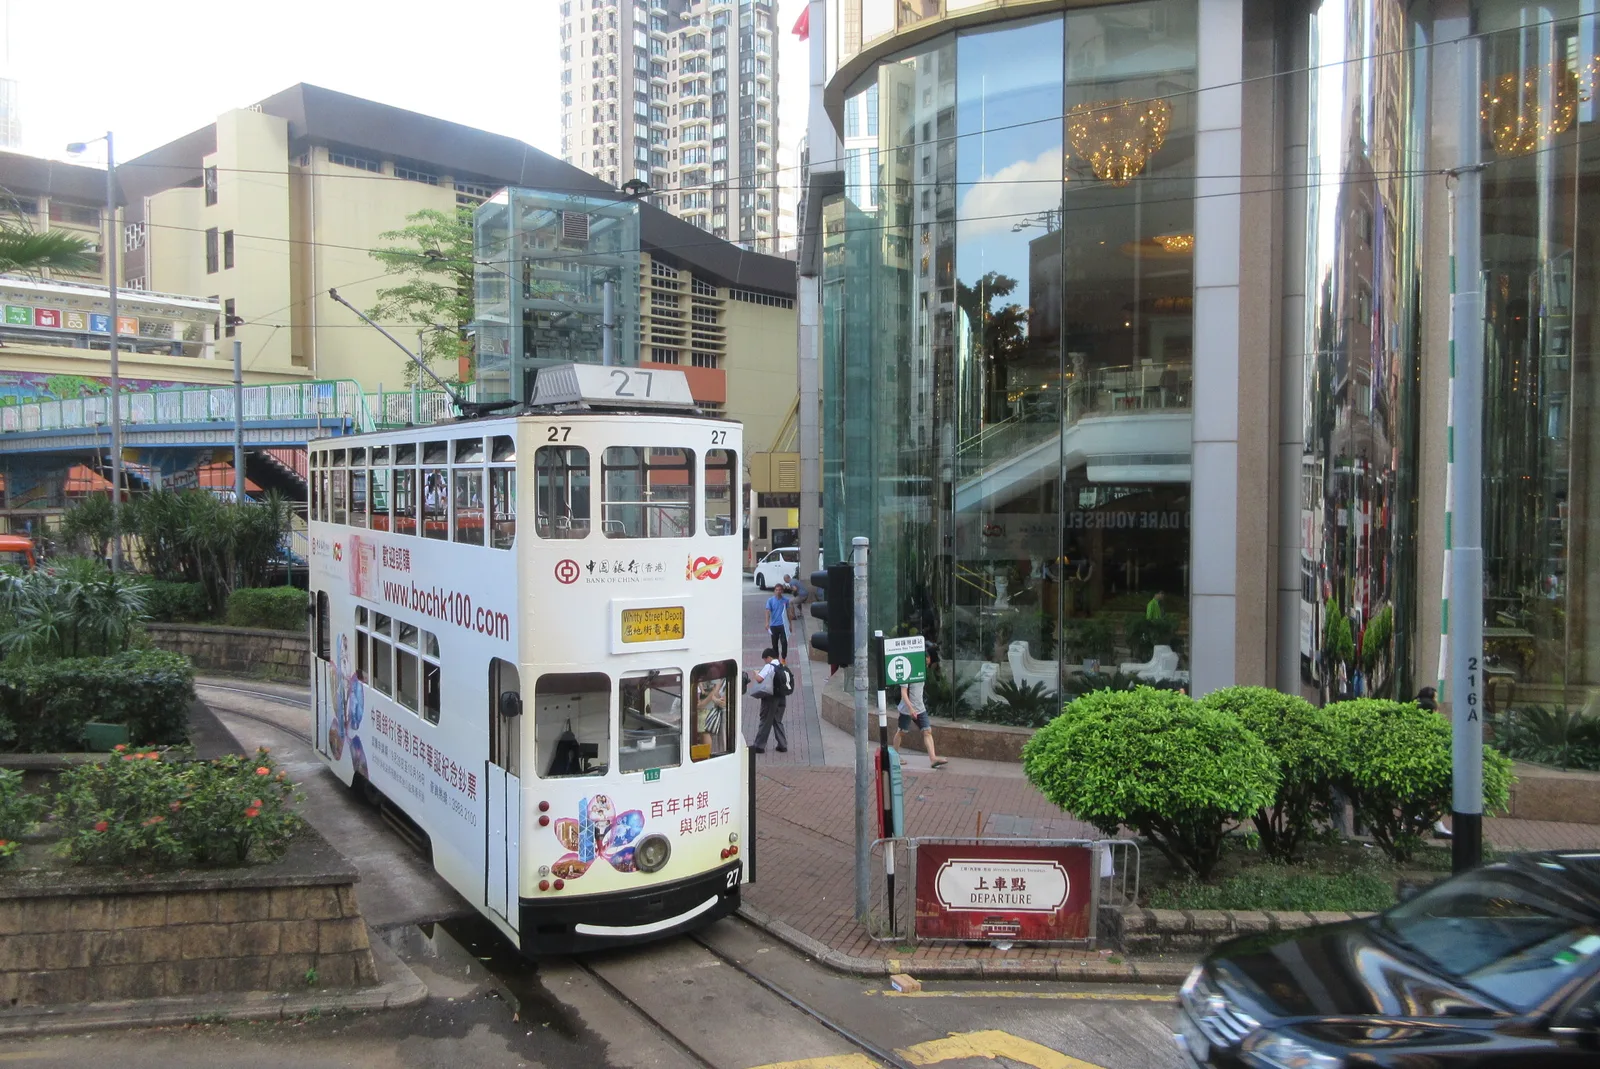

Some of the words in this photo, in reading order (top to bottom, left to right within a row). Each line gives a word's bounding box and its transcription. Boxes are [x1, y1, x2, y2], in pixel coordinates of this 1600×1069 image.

[610, 370, 652, 398] 27
[547, 426, 572, 442] 27
[711, 430, 727, 445] 27
[382, 580, 510, 642] www.bochk100.com
[624, 611, 642, 624] Whitty
[644, 611, 663, 622] Street
[664, 610, 682, 623] Depot
[646, 771, 659, 780] 115
[651, 791, 709, 819] 百年中銀
[680, 806, 730, 836] 與您同行
[726, 868, 739, 889] 27
[974, 876, 1026, 892] 上車點
[970, 892, 1032, 905] DEPARTURE
